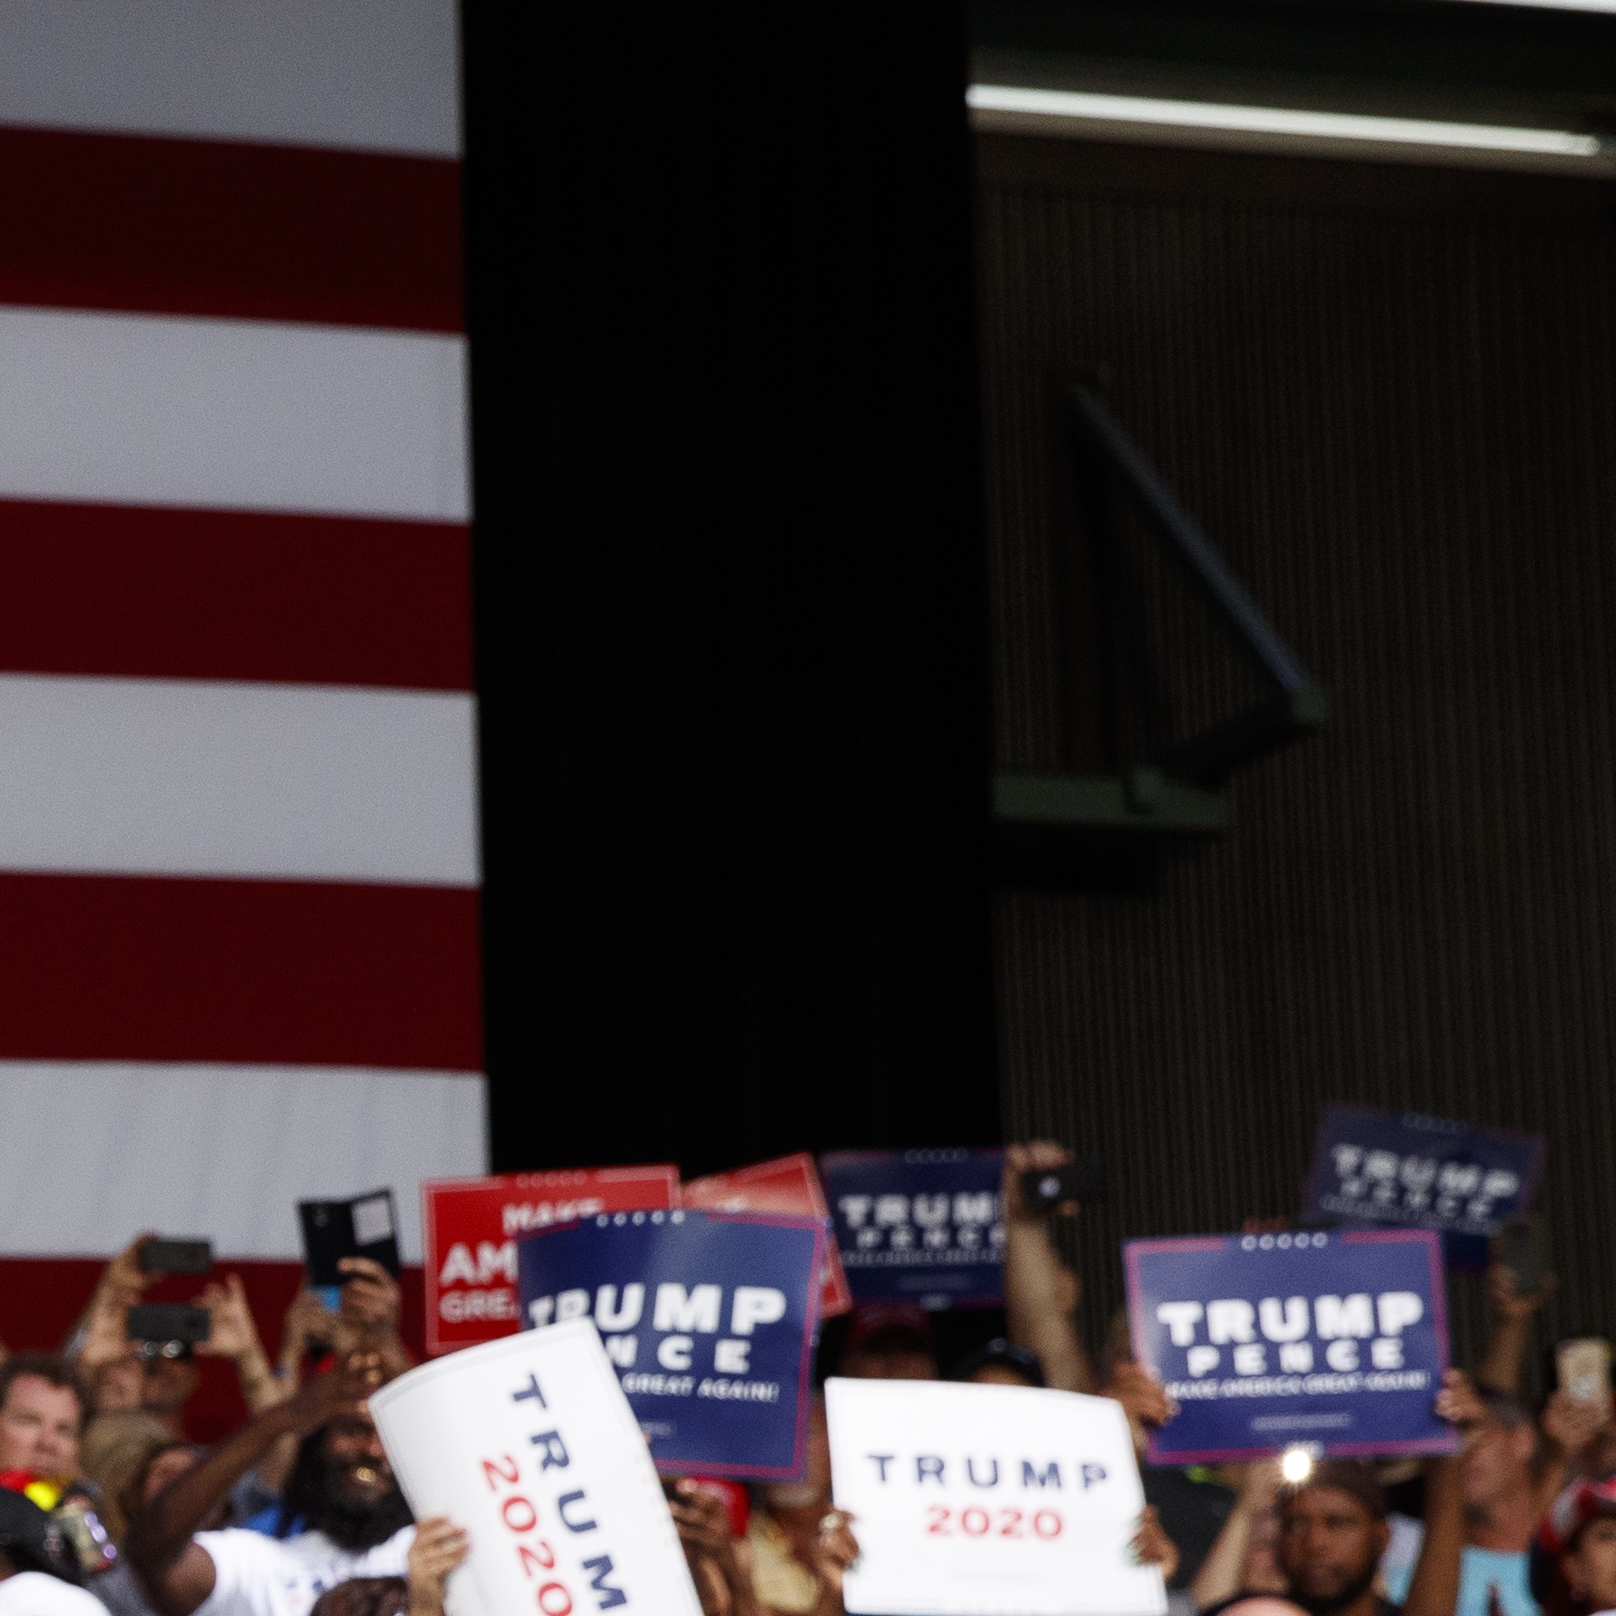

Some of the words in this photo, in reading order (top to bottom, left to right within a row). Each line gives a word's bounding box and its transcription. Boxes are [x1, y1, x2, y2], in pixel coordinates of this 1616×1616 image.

[837, 1191, 1004, 1231] TRUM
[529, 1281, 787, 1336] TRUMP
[1156, 1290, 1424, 1347] TRUMP
[605, 1334, 751, 1375] NCE
[1186, 1337, 1405, 1378] PENCE
[867, 1454, 1108, 1489] TRUMP
[927, 1505, 1064, 1539] 2020
